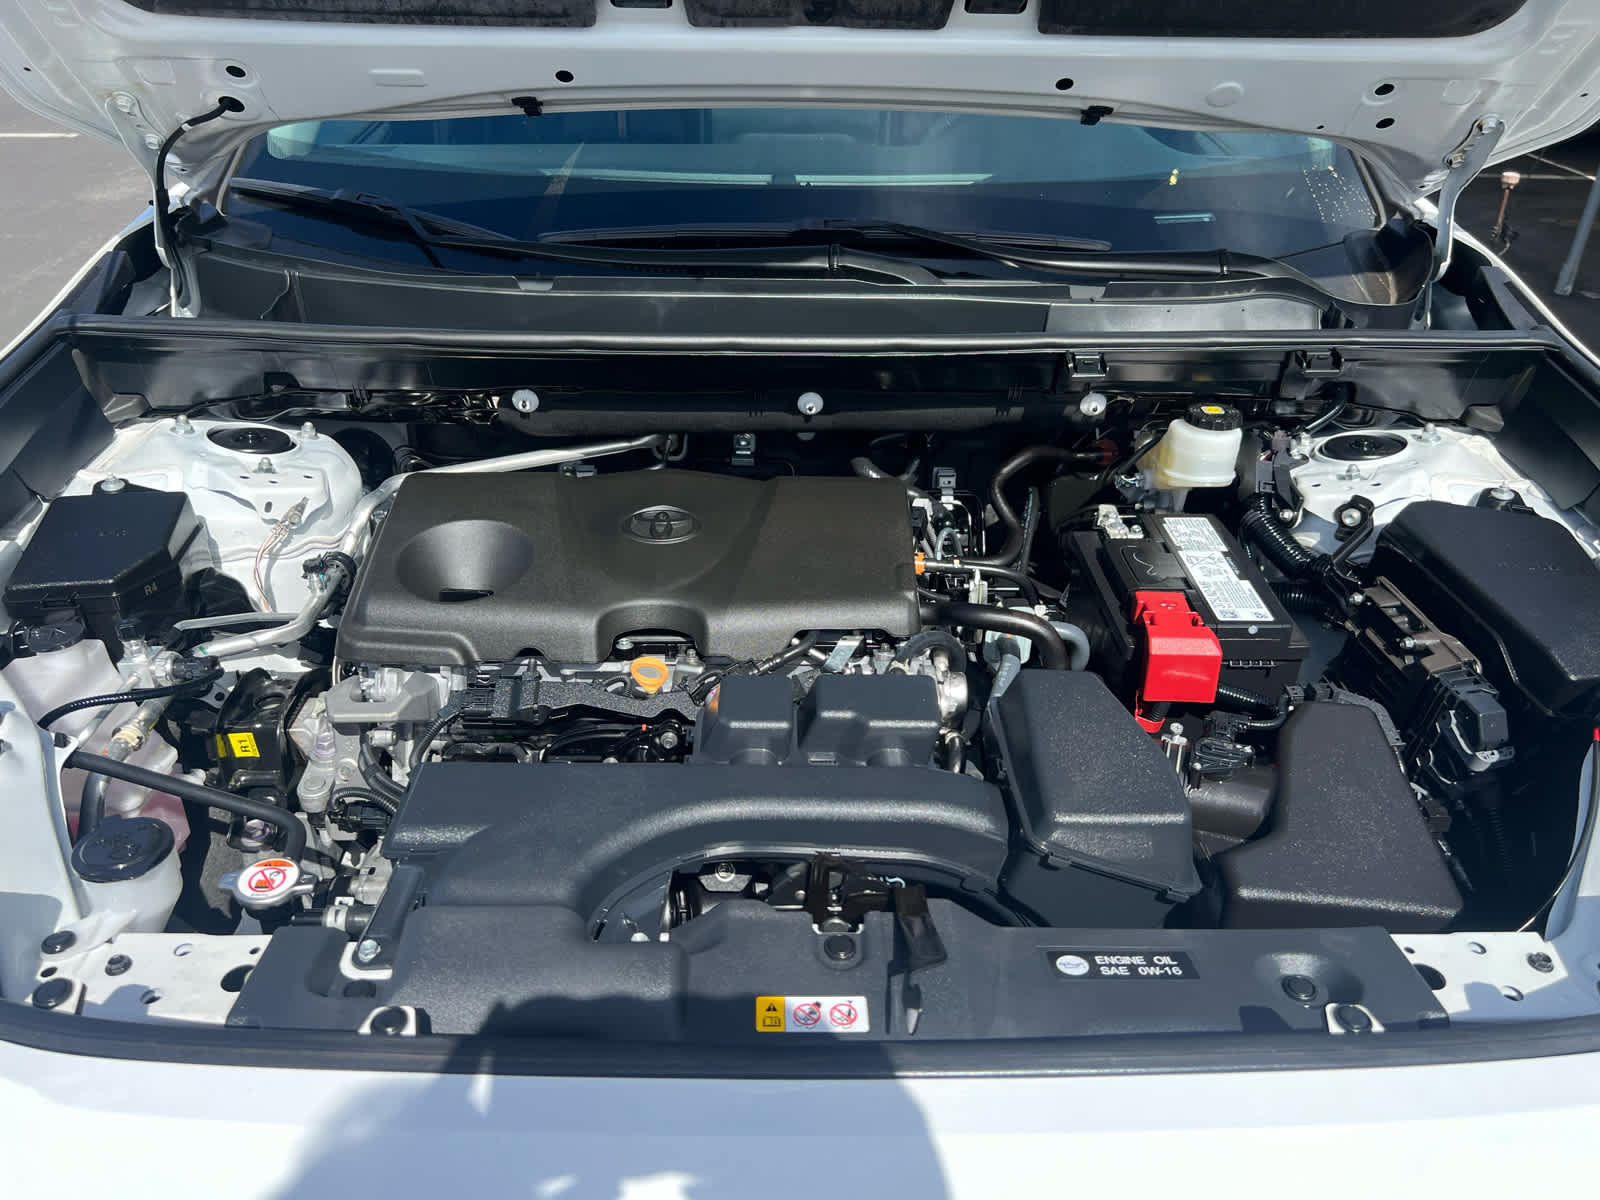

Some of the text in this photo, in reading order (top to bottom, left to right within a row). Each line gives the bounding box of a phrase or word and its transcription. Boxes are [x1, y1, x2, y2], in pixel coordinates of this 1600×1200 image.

[1094, 956, 1177, 965] ENGINE OIL
[1100, 966, 1182, 976] SAE 0W-16
